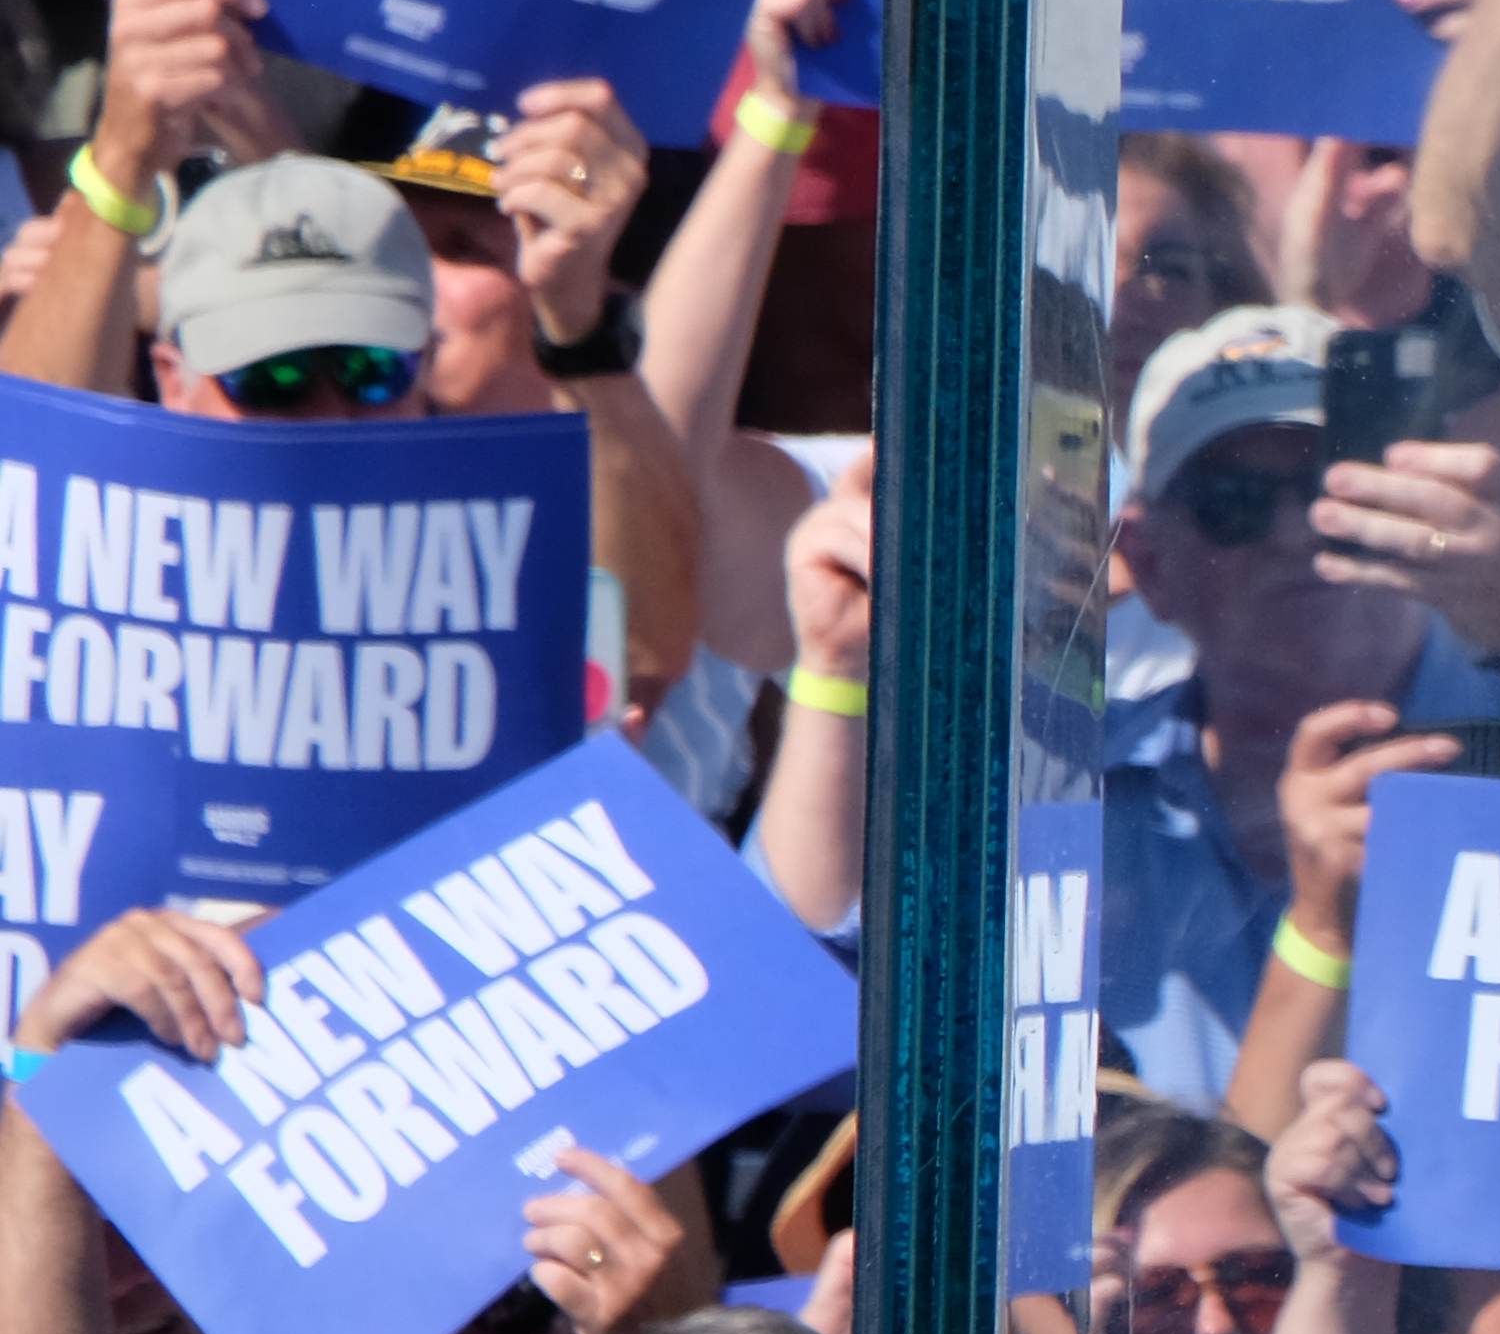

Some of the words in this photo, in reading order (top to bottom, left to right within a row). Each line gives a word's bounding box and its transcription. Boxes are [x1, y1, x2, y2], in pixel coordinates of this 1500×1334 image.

[0, 601, 497, 772] FORWARD
[58, 475, 293, 633] NEW
[312, 496, 535, 639] WAY
[119, 1064, 242, 1192] A
[216, 914, 446, 1128] NEW
[403, 800, 654, 978] WAY
[226, 912, 710, 1269] FORWARD
